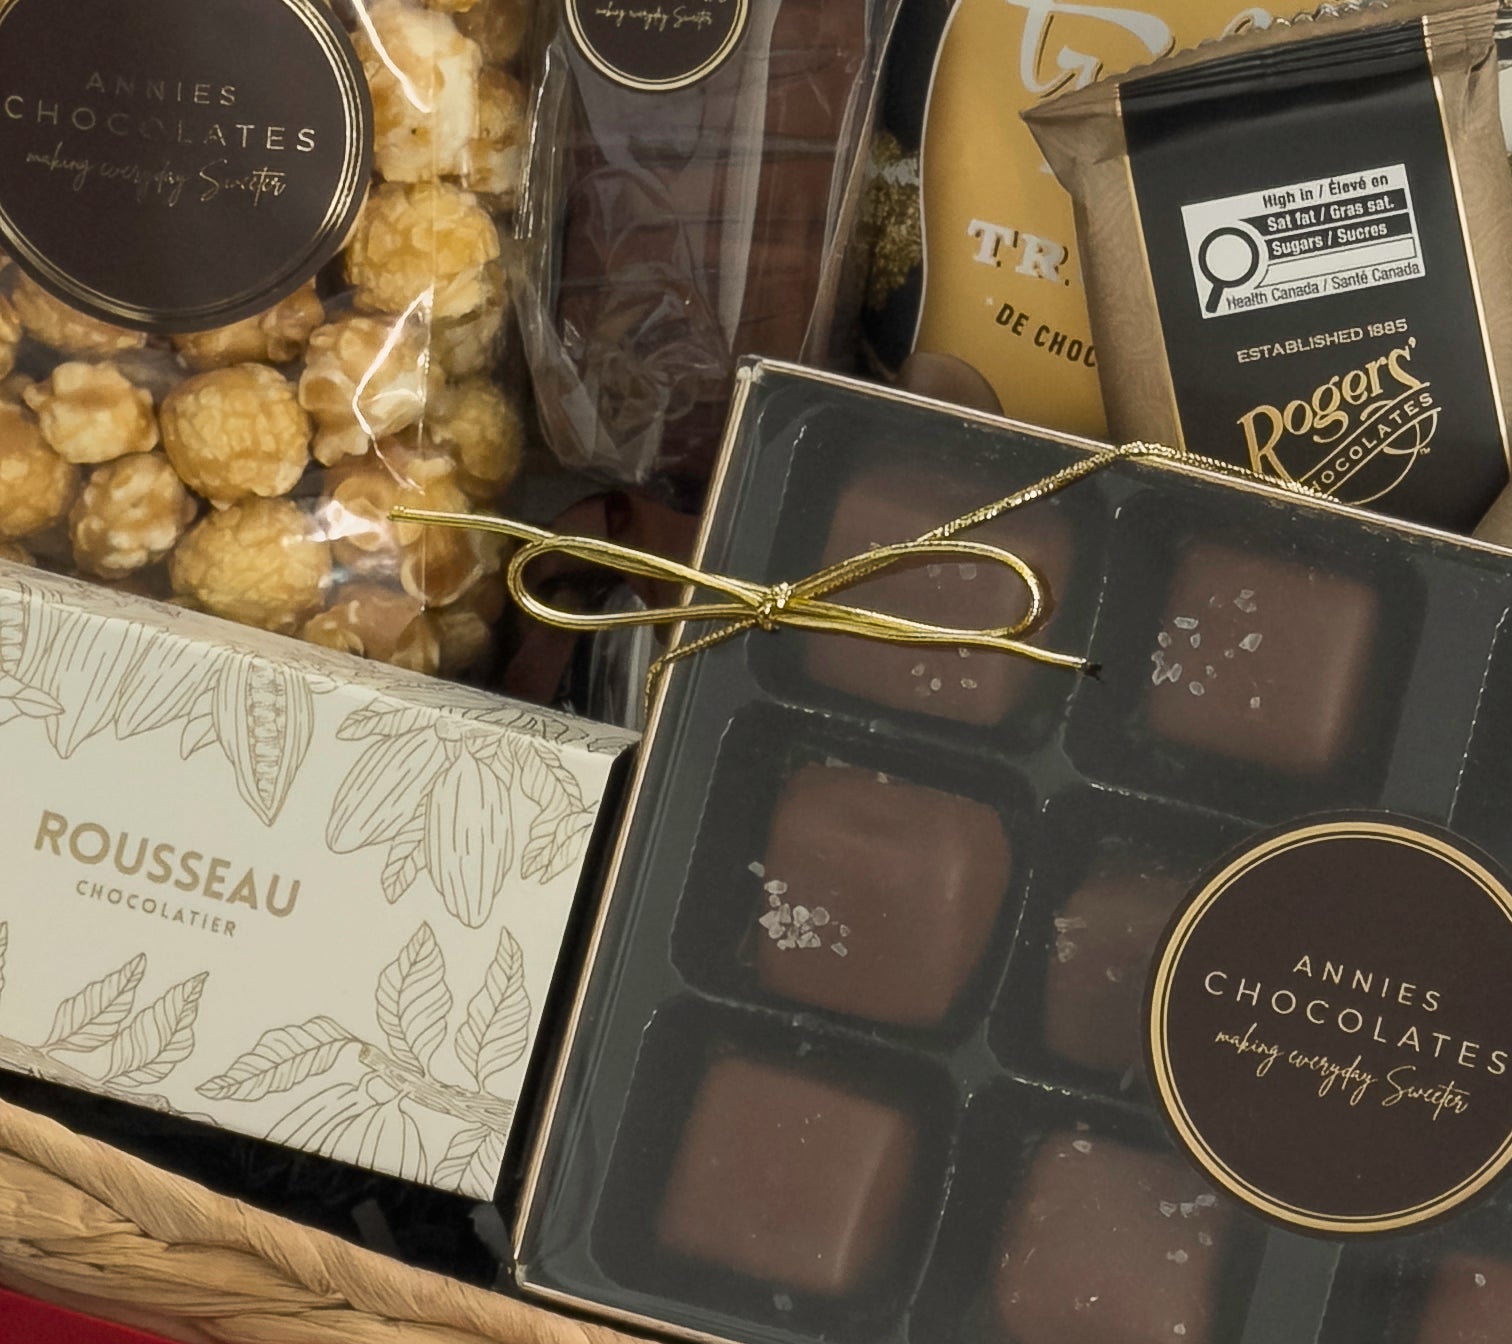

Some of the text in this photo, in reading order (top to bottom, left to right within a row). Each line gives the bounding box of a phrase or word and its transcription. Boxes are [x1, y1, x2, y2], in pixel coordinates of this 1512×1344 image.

[86, 72, 237, 106] ANNIES
[5, 95, 316, 152] CHOCOLATES
[1262, 191, 1295, 209] High
[1300, 188, 1314, 202] in
[1329, 178, 1367, 196] Élevé
[1371, 173, 1389, 187] en
[1267, 215, 1292, 231] Sat
[1297, 210, 1316, 225] fat
[1330, 203, 1363, 220] Gras
[1367, 196, 1394, 212] sat.
[1272, 234, 1323, 256] Sugars
[1337, 222, 1388, 243] Sucres
[1226, 291, 1268, 310] Health
[1272, 281, 1319, 301] Canada
[1332, 271, 1368, 289] Santé
[1372, 262, 1421, 281] Canada
[996, 303, 1029, 336] DE
[1237, 318, 1408, 363] ESTABLISHED 1885
[1310, 392, 1433, 492] OCOLATES
[34, 809, 301, 918] ROUSSEAU
[75, 880, 237, 938] CHOCOLATIER
[1293, 954, 1441, 1012] ANNIES
[1204, 971, 1508, 1075] CHOCOLATES
[1215, 1023, 1471, 1121] making everyday Sweeter
